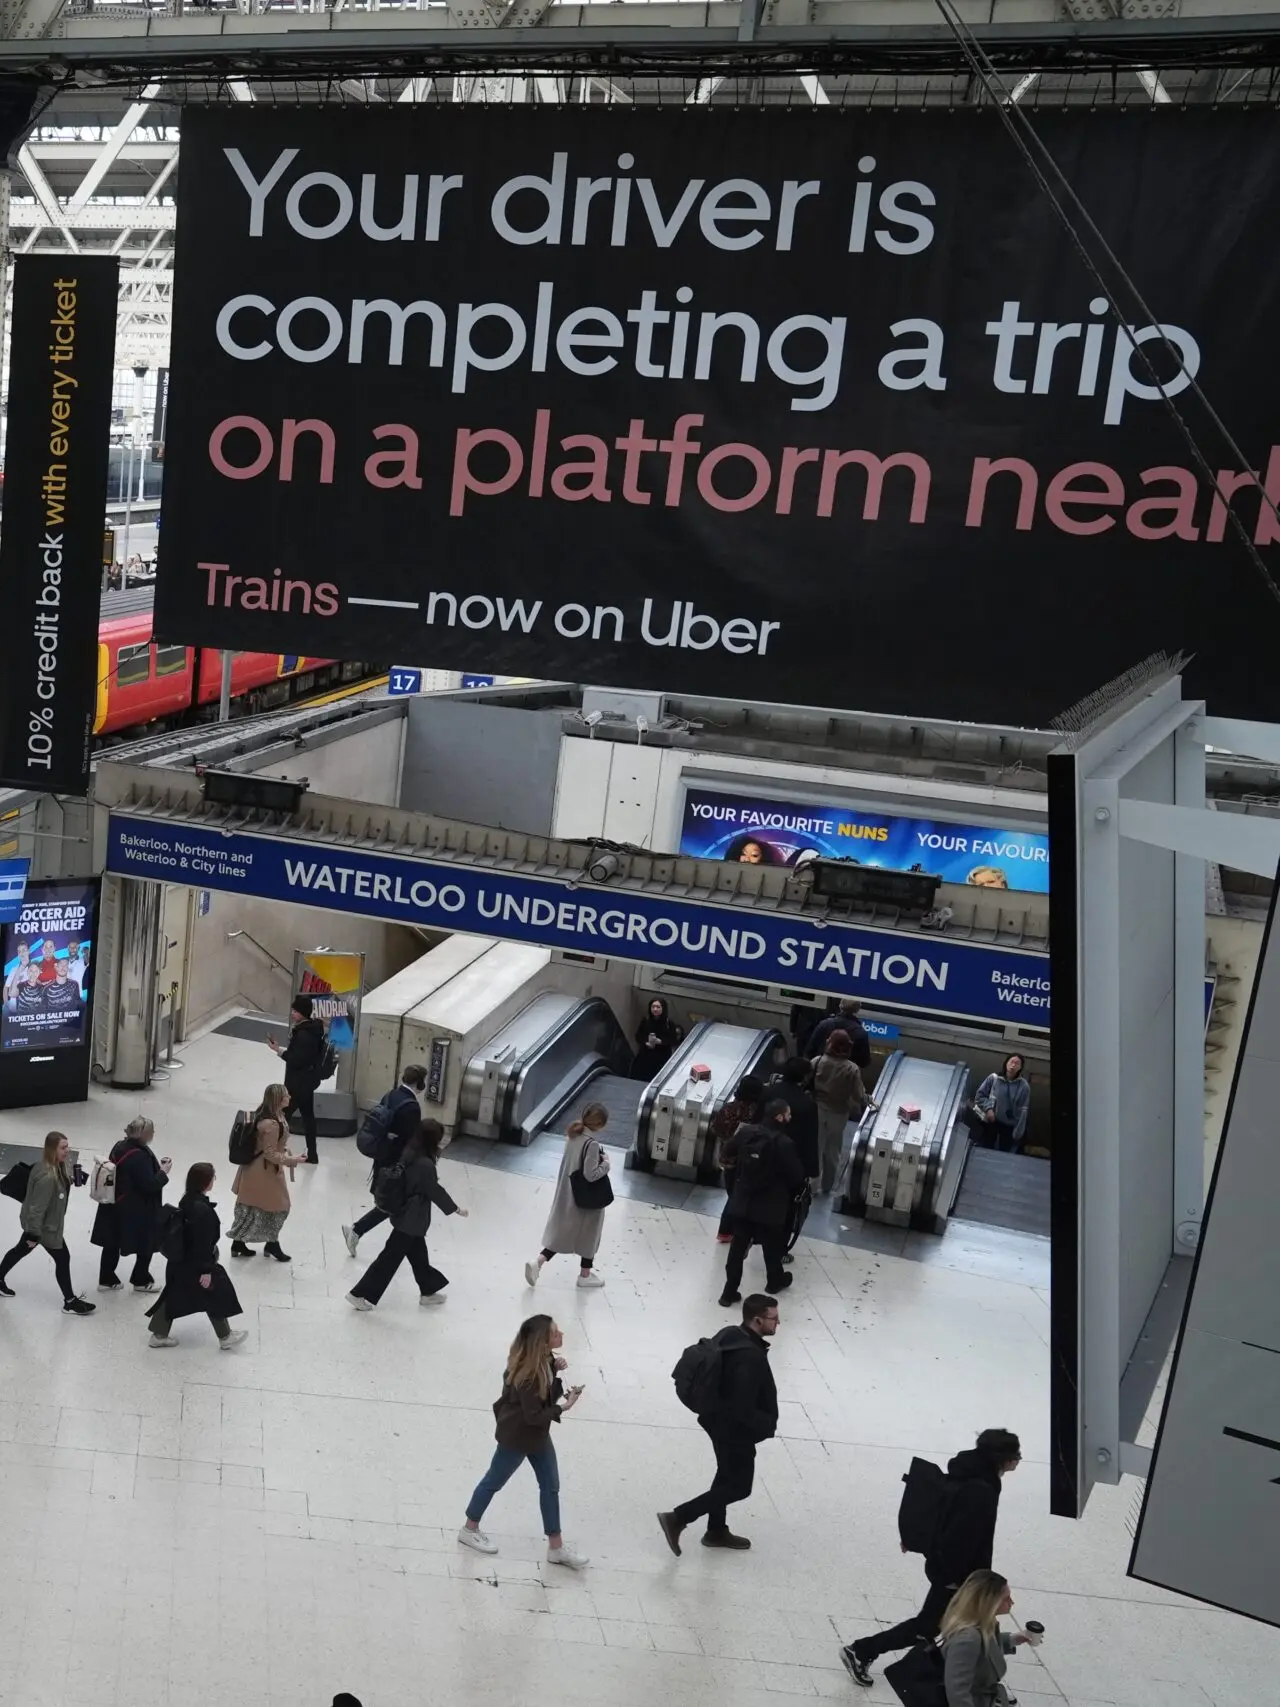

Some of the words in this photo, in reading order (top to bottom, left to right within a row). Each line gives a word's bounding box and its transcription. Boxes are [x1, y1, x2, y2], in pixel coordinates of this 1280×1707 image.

[223, 148, 463, 241] Your
[491, 152, 819, 251] driver
[849, 155, 936, 255] is
[50, 278, 78, 363] ticket
[215, 282, 847, 412] completing
[878, 318, 947, 391] a
[985, 297, 1201, 425] trip
[50, 370, 78, 455] every
[209, 415, 335, 484] on
[364, 423, 422, 490] a
[449, 408, 931, 524] platform
[41, 464, 67, 526] with
[35, 532, 64, 606] back
[197, 562, 339, 617] Trains
[426, 591, 543, 634] now
[554, 603, 624, 642] on
[640, 598, 780, 655] Uber
[34, 611, 60, 699] credit
[393, 675, 415, 691] 17
[27, 707, 54, 769] 10%
[690, 803, 737, 822] YOUR
[740, 810, 833, 835] FAVOURITE
[838, 823, 888, 842] NUNS
[917, 832, 968, 852] YOUR
[120, 833, 171, 852] Bakerloo,
[175, 842, 228, 860] Northern
[231, 853, 253, 865] and
[124, 848, 177, 866] Waterloo
[180, 857, 189, 868] &
[191, 859, 216, 875] City
[218, 863, 246, 878] lines
[14, 922, 39, 934] FOR
[42, 919, 85, 933] UNICEF
[20, 908, 62, 921] OCCER
[64, 906, 86, 918] AID
[283, 859, 467, 912] WATERLOO
[477, 889, 767, 961] UNDERGROUND
[777, 937, 950, 992] STATION
[991, 970, 1050, 991] Bakerlo
[997, 988, 1050, 1009] Waterl
[8, 1014, 35, 1023] TICKETS
[47, 1011, 62, 1020] SALE
[64, 1010, 80, 1018] NOW
[310, 998, 349, 1019] ANDRAIL
[862, 1021, 888, 1035] lobal
